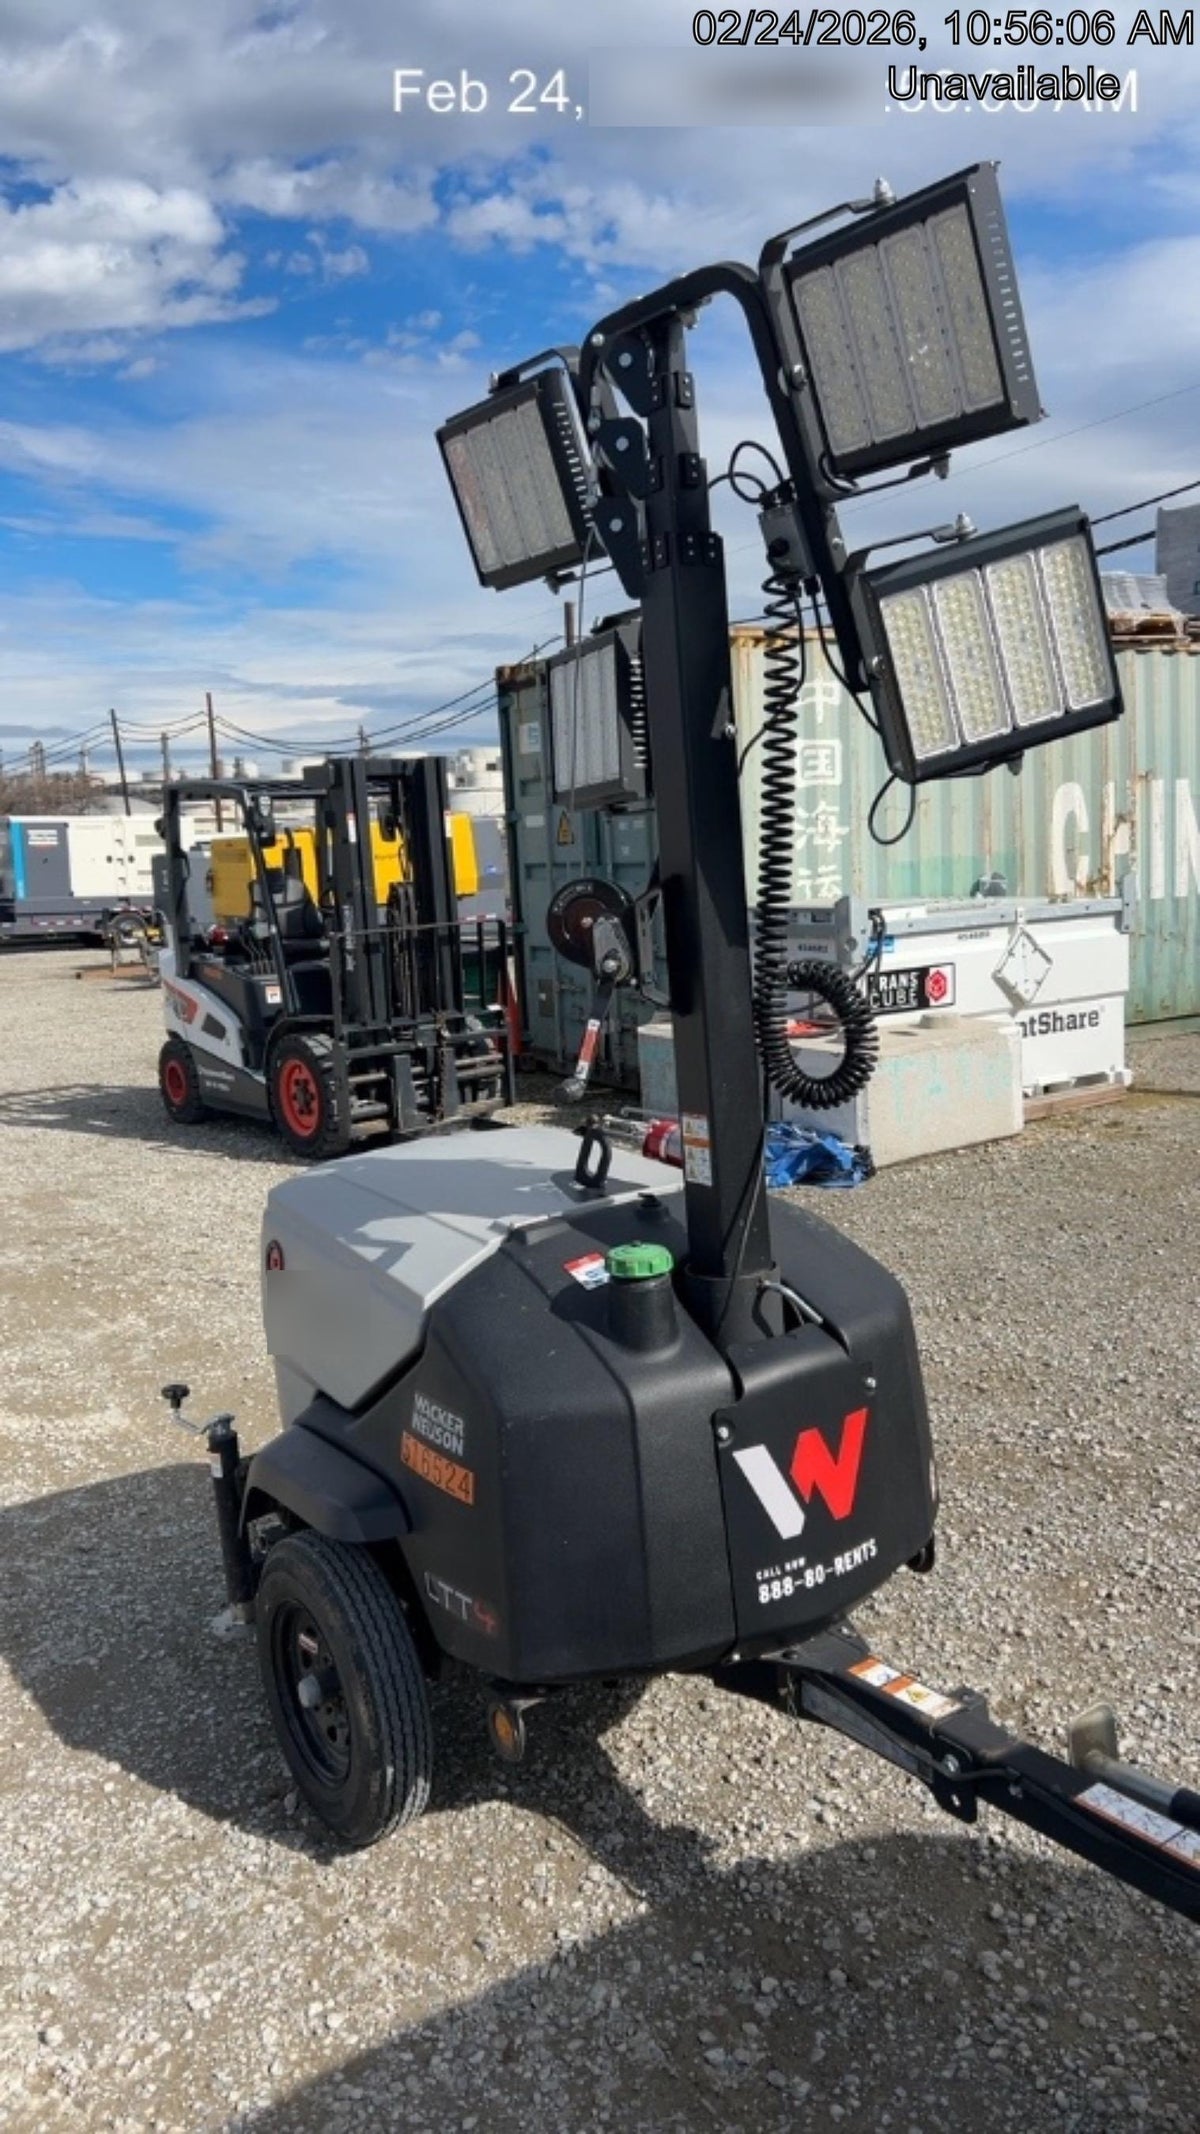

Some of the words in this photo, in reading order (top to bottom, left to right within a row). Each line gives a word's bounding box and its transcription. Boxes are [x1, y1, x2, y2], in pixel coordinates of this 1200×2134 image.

[868, 971, 920, 993] RANS
[870, 985, 919, 1009] CUBE
[414, 1392, 464, 1437] WACKER
[412, 1412, 464, 1457] NEUSON
[756, 1565, 782, 1581] CALL
[758, 1538, 878, 1604] 888-80-RENTS
